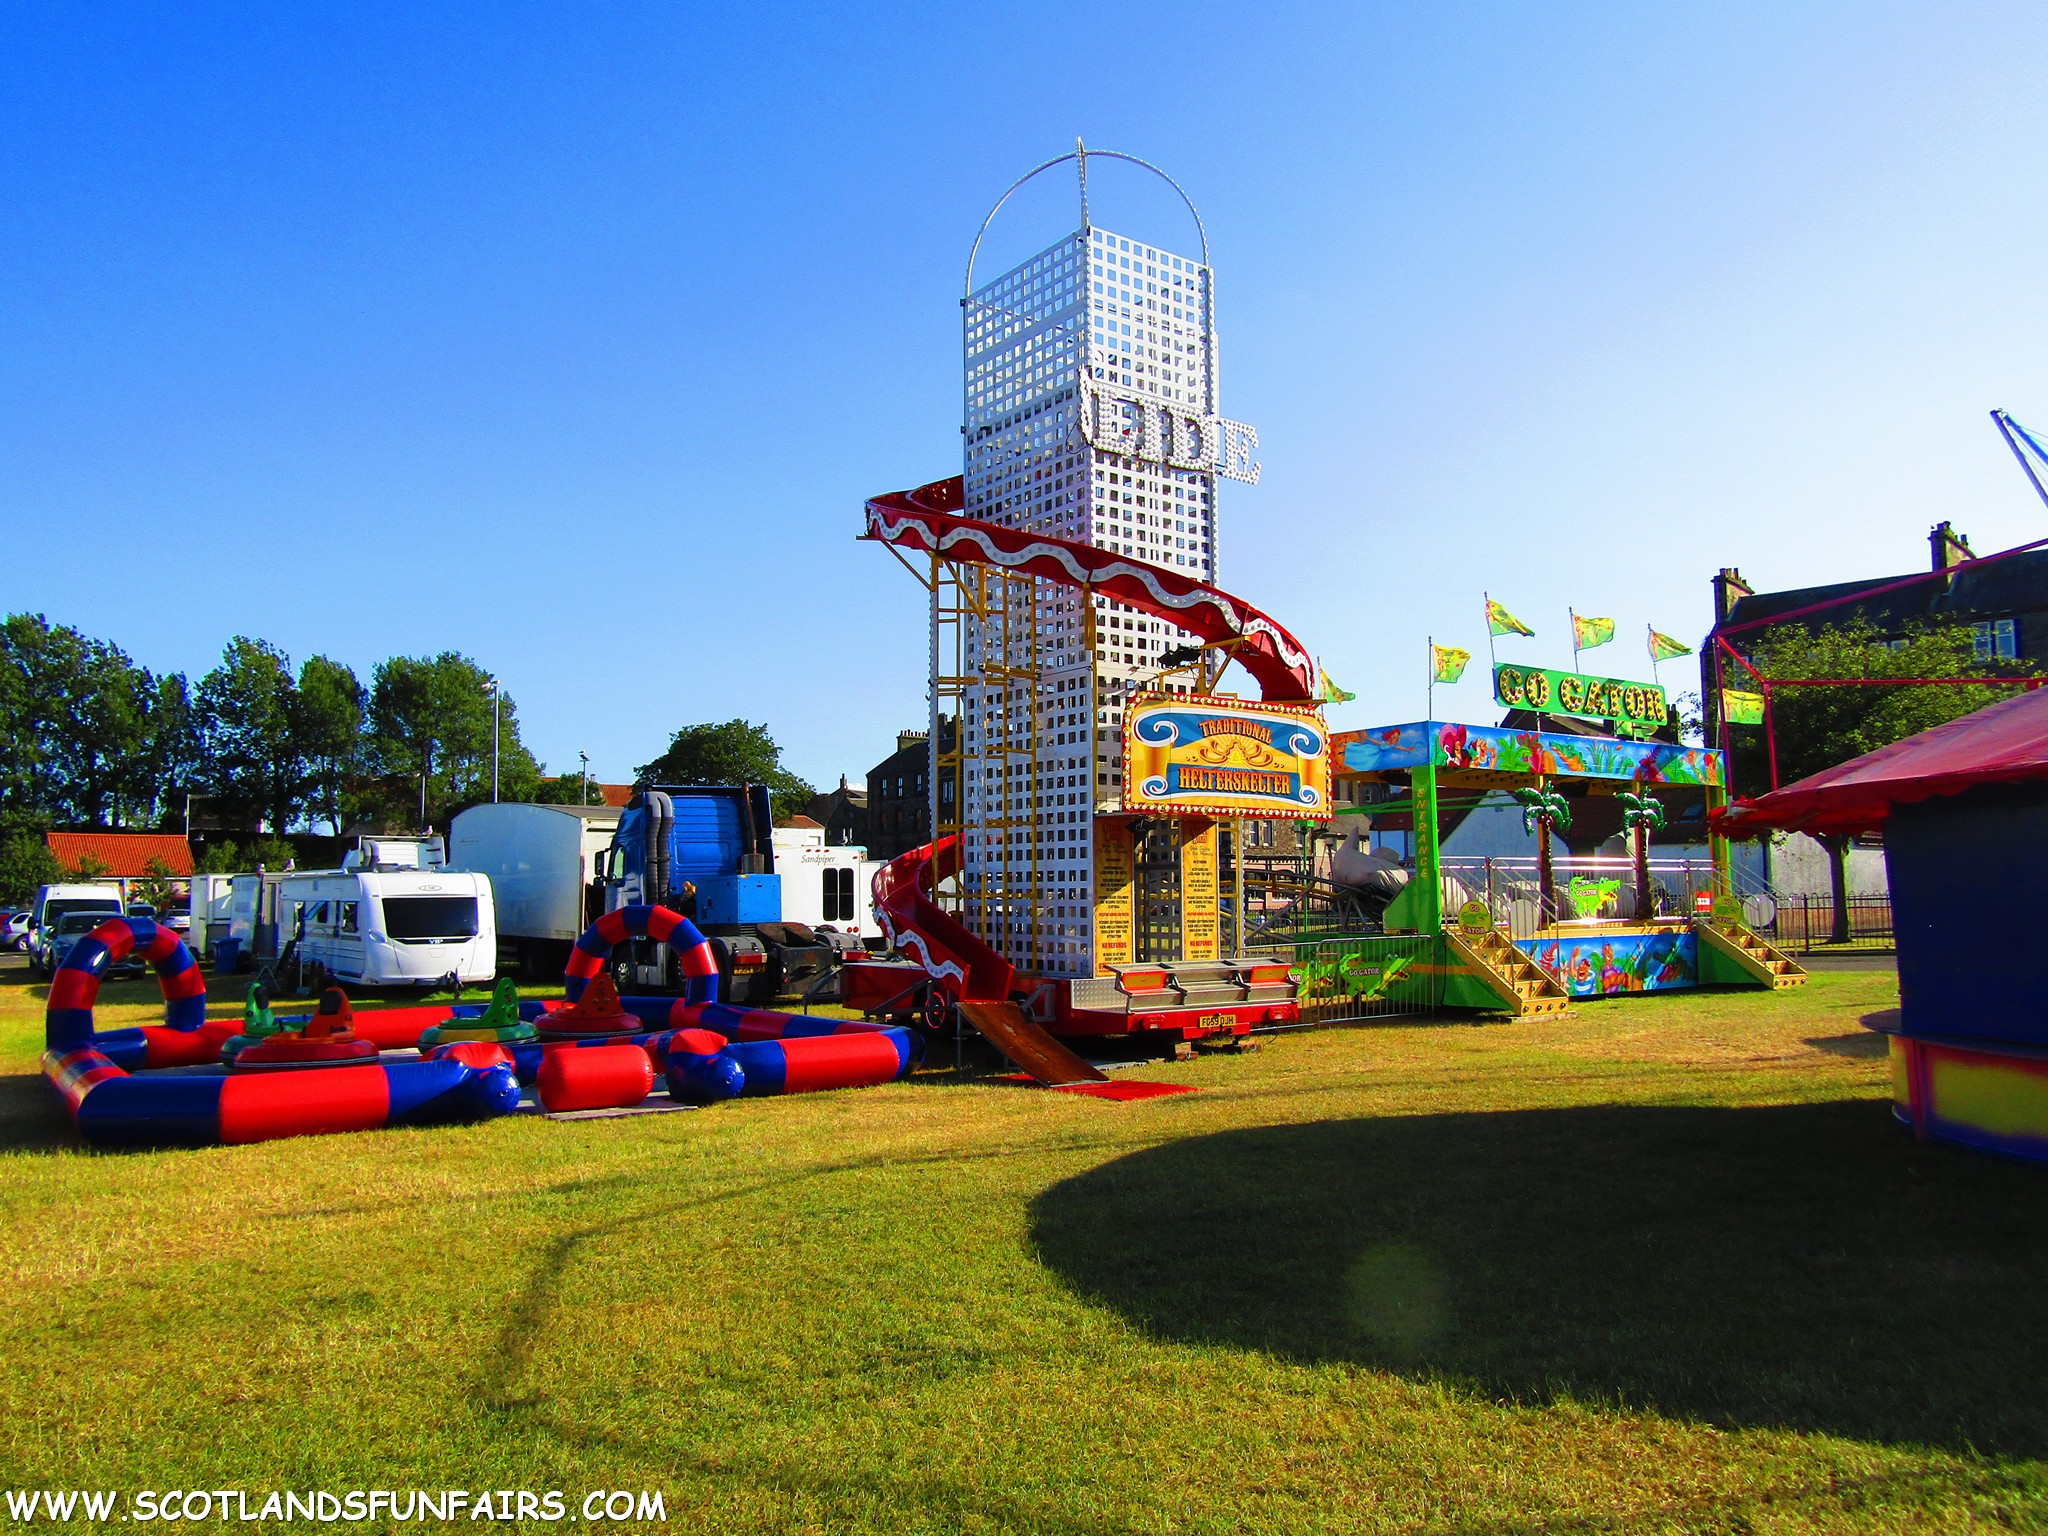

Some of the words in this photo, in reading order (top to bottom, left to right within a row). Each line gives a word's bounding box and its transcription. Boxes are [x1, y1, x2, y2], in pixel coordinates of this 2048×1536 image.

[1499, 668, 1551, 707] GO
[1560, 676, 1668, 722] GATOR
[1199, 717, 1272, 745] TRADITIONAL
[1416, 787, 1429, 878] ENTRANCE
[801, 854, 837, 866] Sandpiper
[1469, 904, 1479, 912] GO
[1713, 914, 1736, 924] GATOR
[1462, 925, 1485, 934] GATOR
[1359, 967, 1380, 976] GATOR
